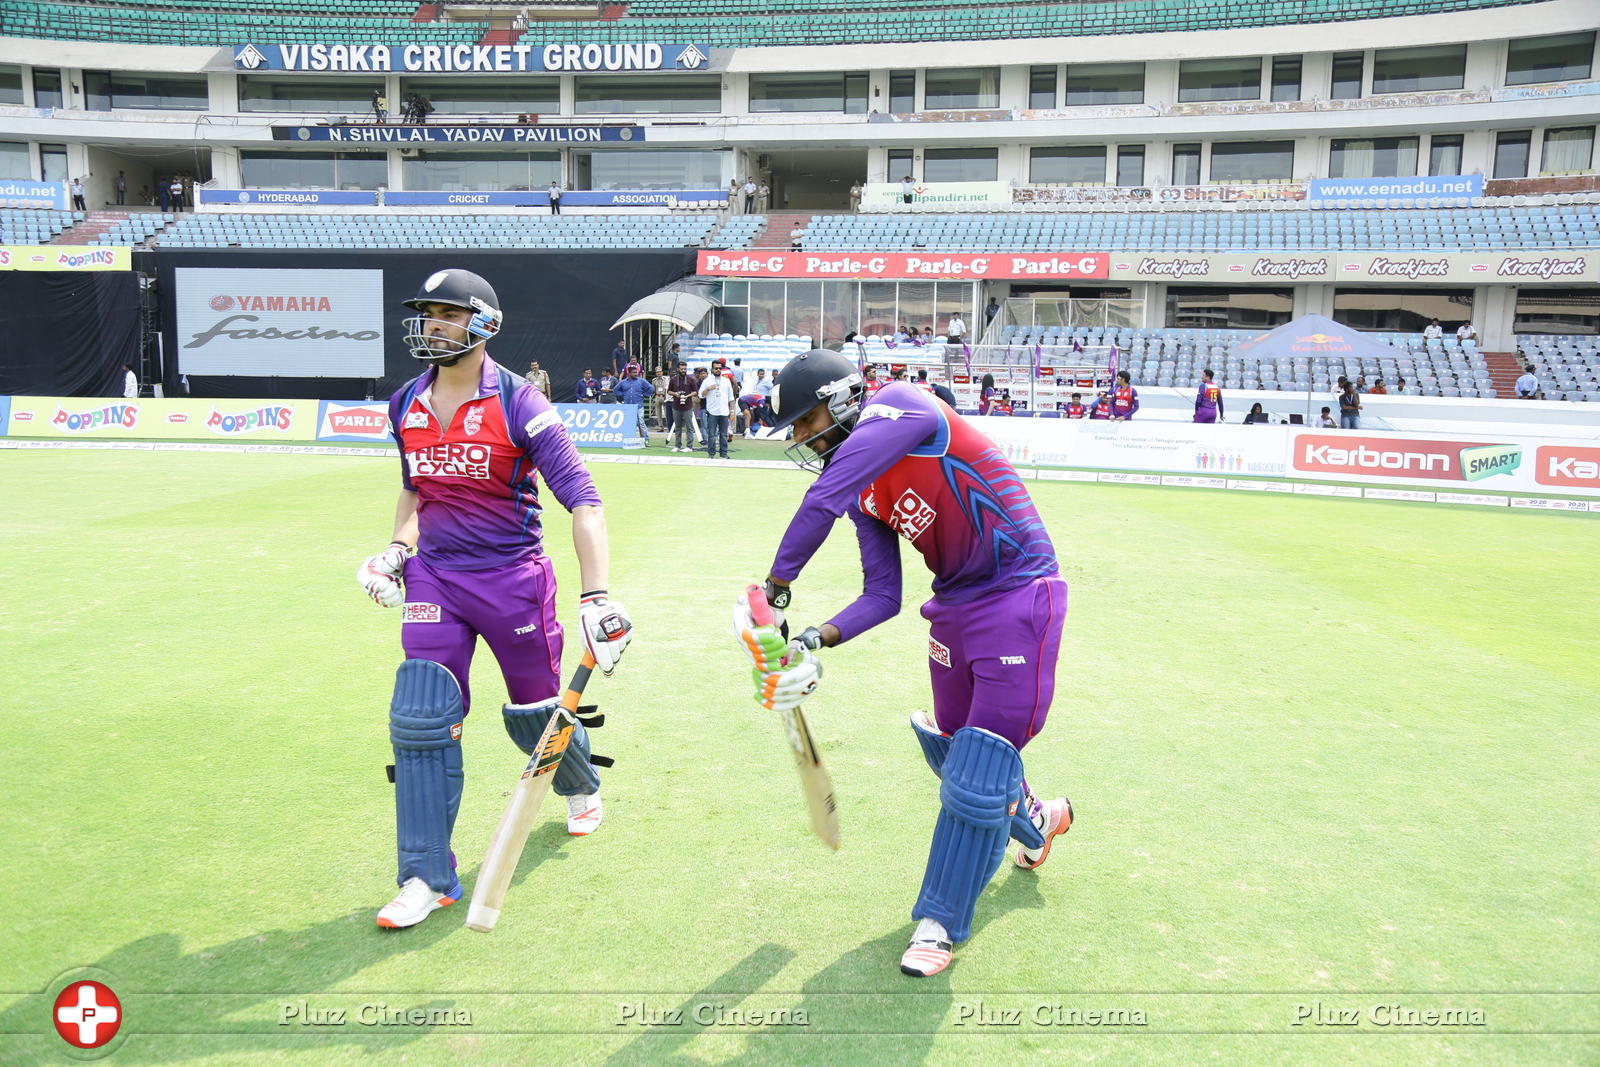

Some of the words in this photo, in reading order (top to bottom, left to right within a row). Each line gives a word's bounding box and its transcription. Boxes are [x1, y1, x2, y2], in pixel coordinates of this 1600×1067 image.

[280, 44, 391, 71] VISAKA
[403, 44, 531, 72] CRICKET
[543, 43, 663, 71] GROUND
[442, 127, 504, 142] YADAV
[514, 128, 601, 142] PAVILION
[1320, 180, 1473, 196] www.eenadu.net
[258, 193, 319, 203] HYDERABAD
[448, 194, 490, 204] CRICKET
[612, 194, 677, 204] ASSOCIATION
[895, 192, 988, 204] pllipandiri.net
[58, 251, 114, 267] POPPINS
[706, 255, 785, 273] Parle-G
[806, 257, 887, 274] Parle-G
[906, 257, 988, 275] Parle-G
[1011, 257, 1097, 275] Parle-G
[1368, 257, 1449, 279] Krackjack
[1498, 257, 1587, 279] Krackjack
[1137, 258, 1209, 279] Krackjack
[1252, 258, 1328, 279] Krackjack
[236, 295, 332, 312] YAMAHA
[183, 314, 381, 349] fascino
[53, 405, 138, 430] POPPINS
[207, 407, 293, 432] POPPINS
[334, 415, 384, 427] PARLE
[564, 409, 624, 429] 20-20
[568, 429, 624, 442] ookies
[415, 444, 488, 464] HERO
[1305, 444, 1450, 472] Karbonn
[1470, 453, 1518, 473] SMART
[416, 462, 488, 478] CYCLES
[407, 604, 438, 614] HERO
